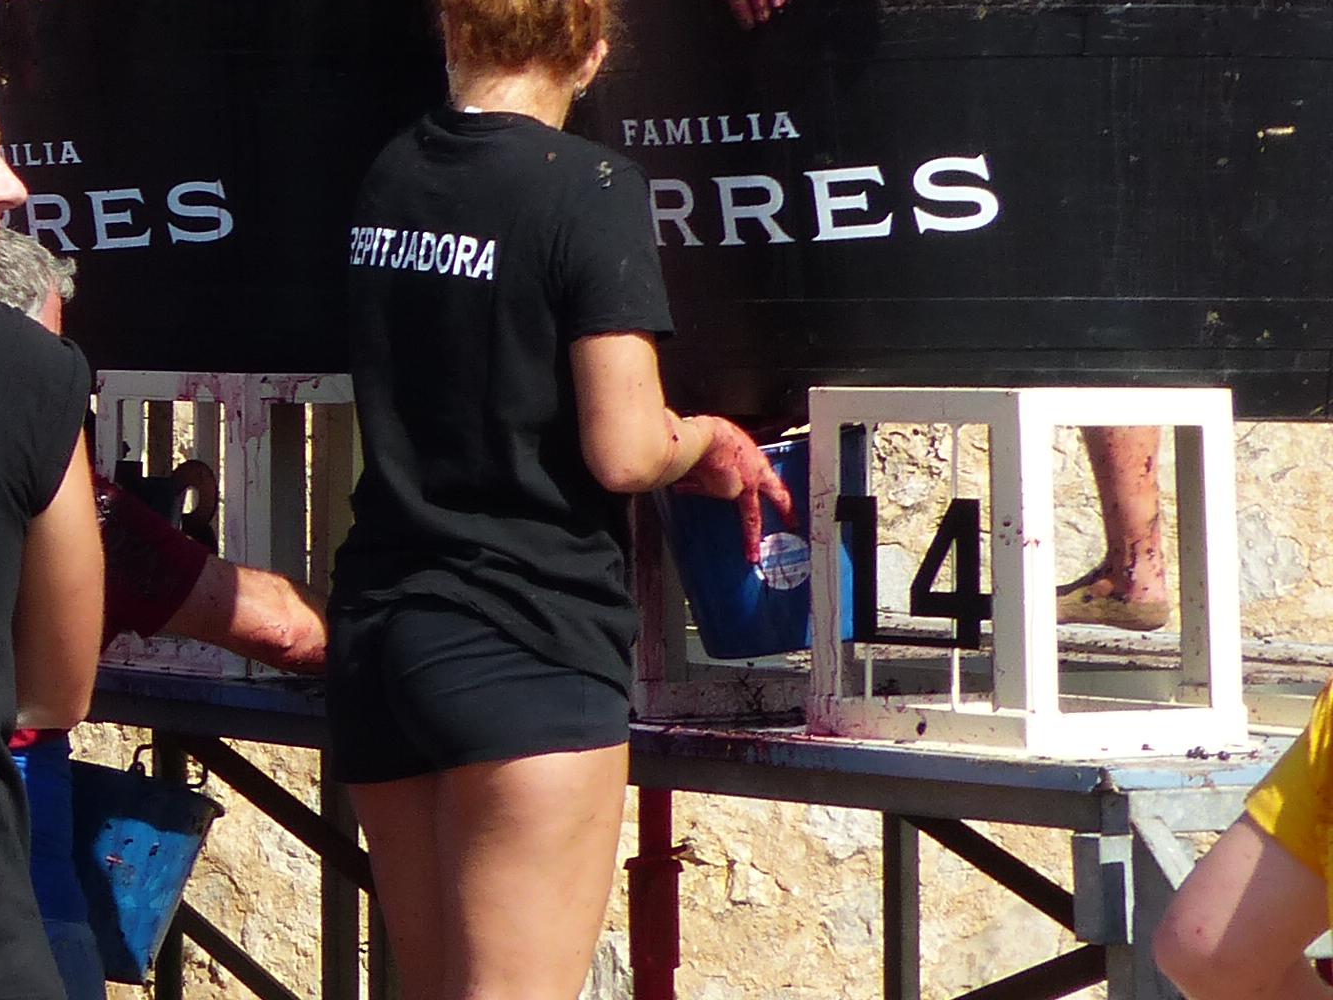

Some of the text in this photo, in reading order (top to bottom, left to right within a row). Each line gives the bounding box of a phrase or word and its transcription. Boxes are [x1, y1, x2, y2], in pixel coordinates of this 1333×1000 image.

[0, 141, 83, 167] ILIA
[622, 112, 801, 147] FAMILIA
[26, 178, 234, 251] RES
[649, 154, 999, 248] RRES
[350, 226, 496, 281] REPITJADORA
[835, 495, 993, 650] 14
